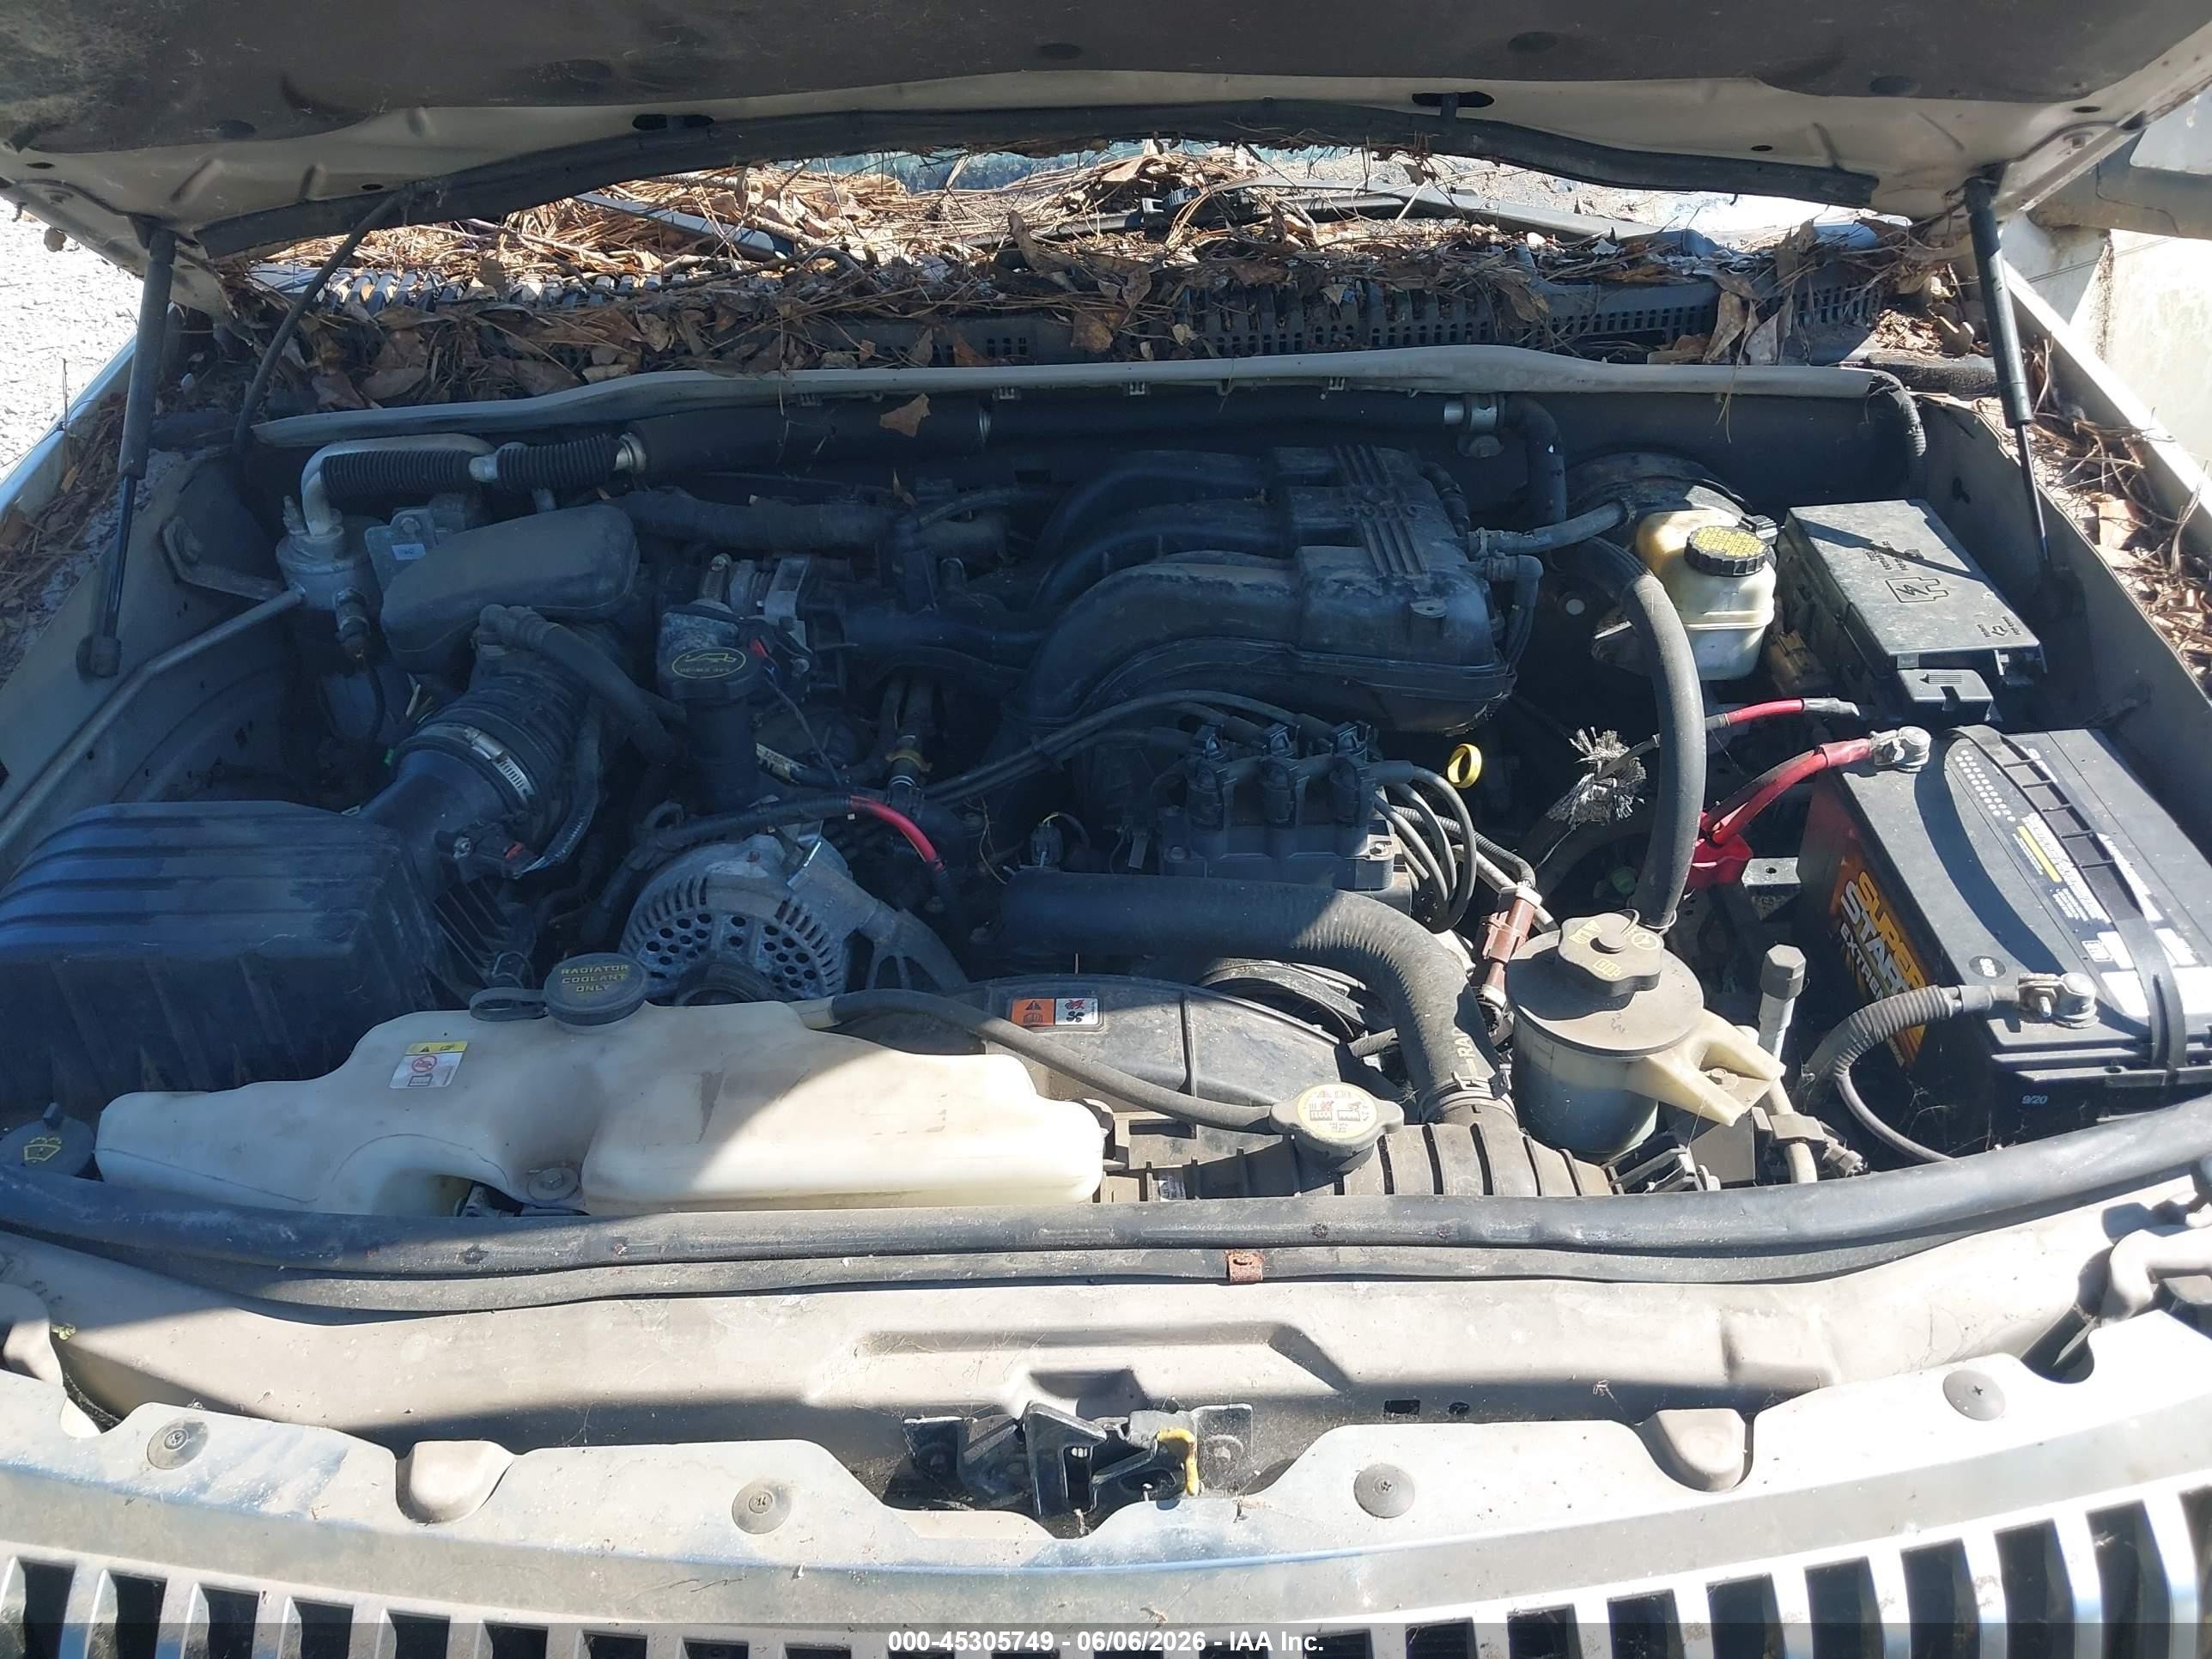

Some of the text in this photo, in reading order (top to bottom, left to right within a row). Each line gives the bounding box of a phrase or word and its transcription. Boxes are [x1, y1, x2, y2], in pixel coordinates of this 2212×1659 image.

[1857, 871, 1927, 990] SUPER
[561, 963, 629, 975] RADIATOR
[561, 973, 629, 984] COOLANT
[576, 983, 611, 993] ONLY
